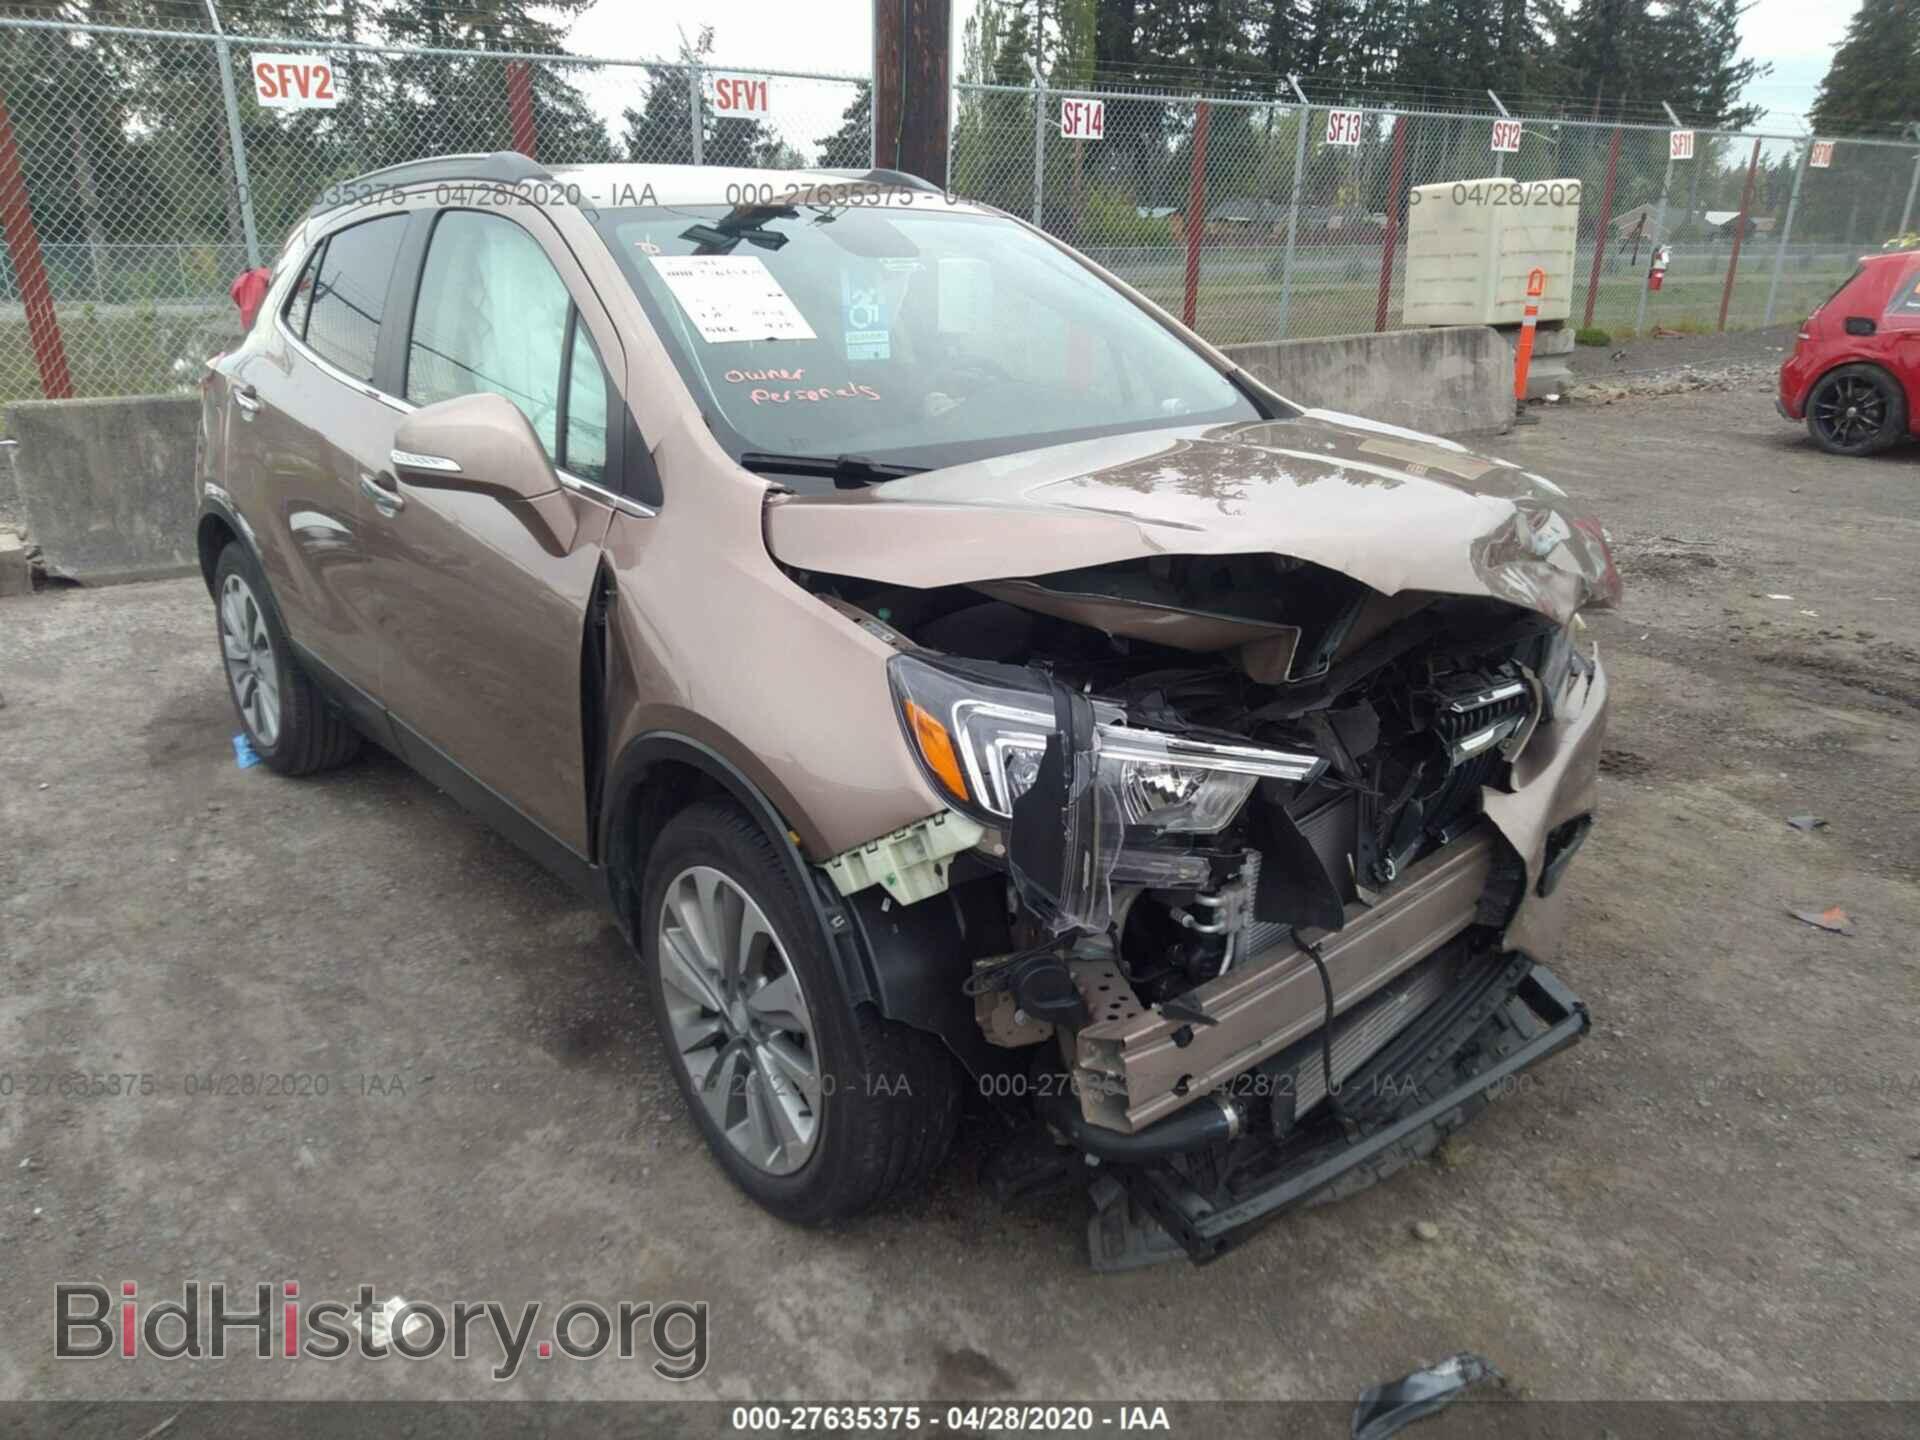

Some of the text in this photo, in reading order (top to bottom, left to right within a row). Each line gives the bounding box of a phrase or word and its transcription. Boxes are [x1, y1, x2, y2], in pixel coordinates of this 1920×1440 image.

[256, 63, 334, 100] SFV2
[716, 78, 768, 112] SFV1
[1063, 101, 1102, 136] SF14
[1328, 112, 1361, 143] SF13
[1493, 121, 1519, 149] SF12
